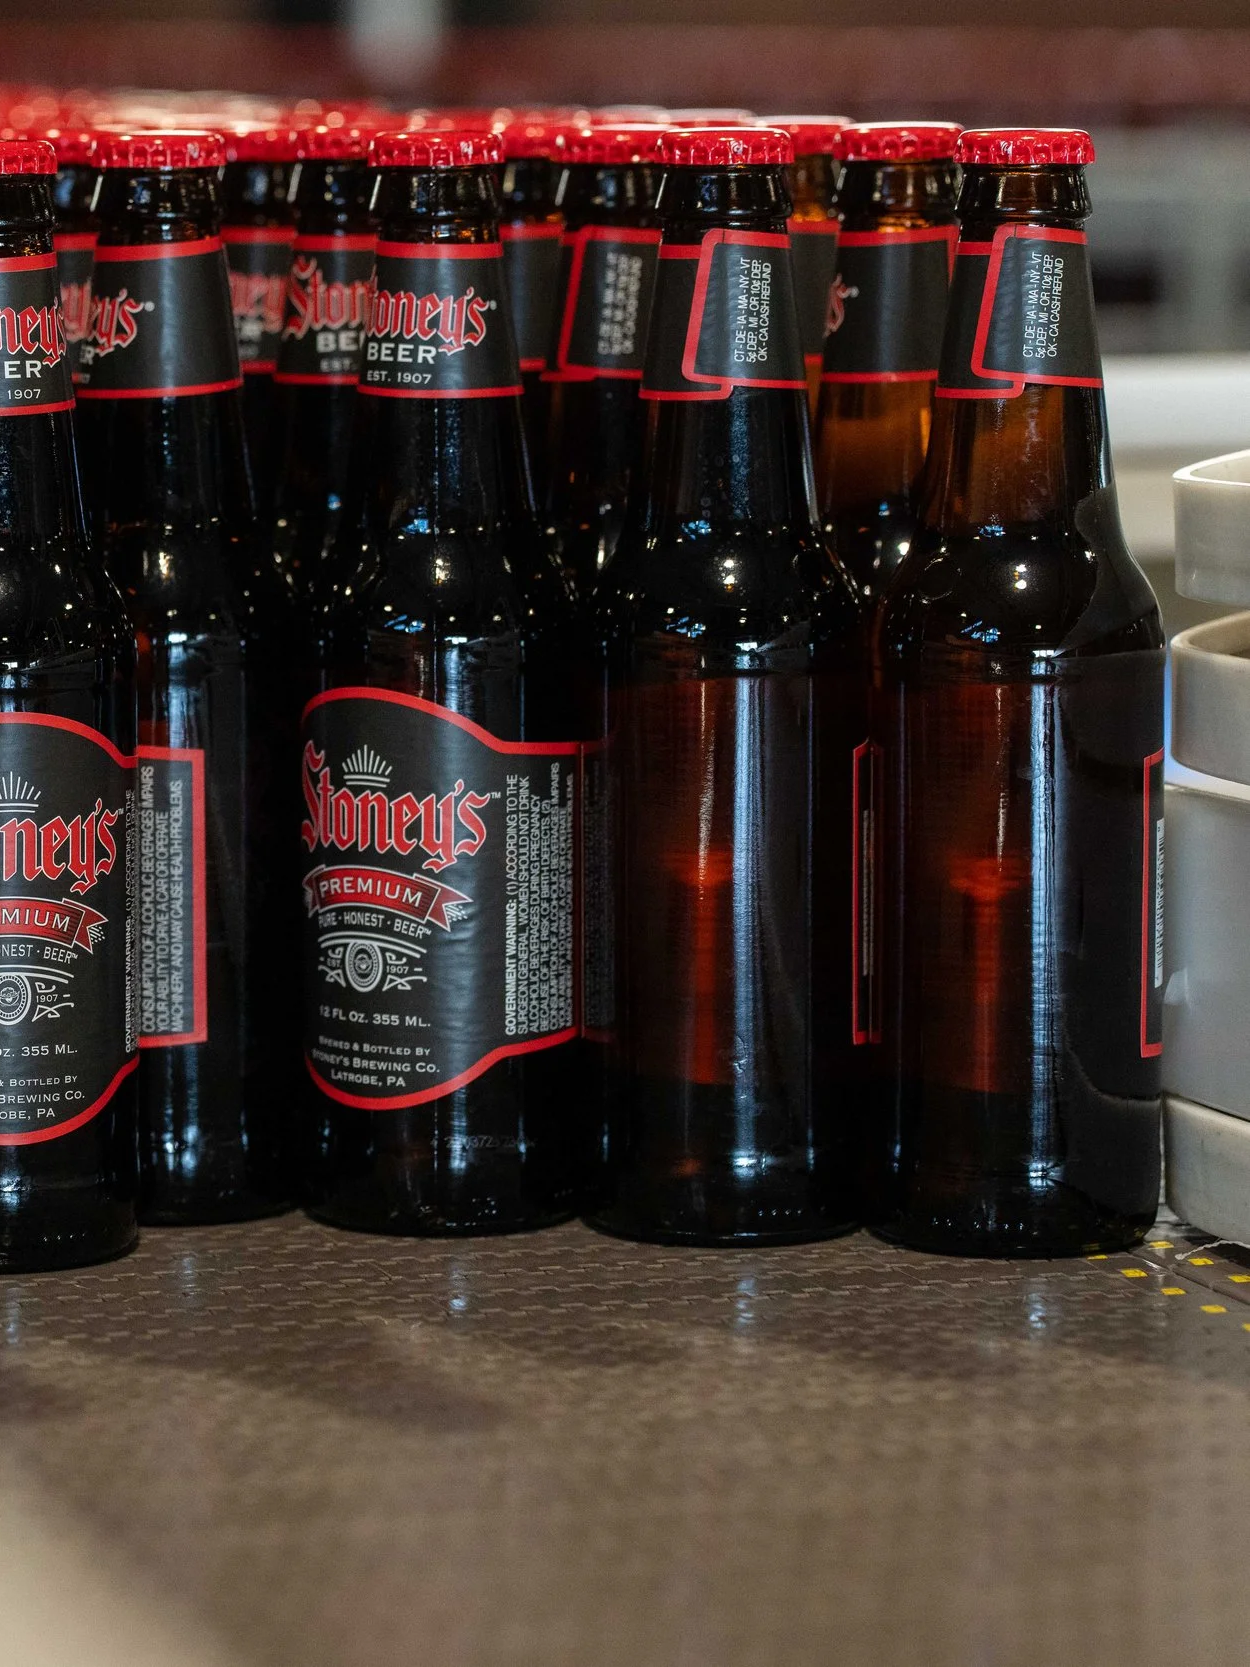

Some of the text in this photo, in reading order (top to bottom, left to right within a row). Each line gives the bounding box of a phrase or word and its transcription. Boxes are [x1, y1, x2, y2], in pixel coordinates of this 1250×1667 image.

[750, 297, 760, 310] OR
[1023, 251, 1042, 357] CT DE IA MA NY VT
[1040, 292, 1050, 306] OR
[1047, 258, 1064, 357] OK CA CASH REFUND
[734, 257, 750, 362] CT DE IA MA NY VT
[758, 263, 771, 361] OK CA CASH REFUND
[1038, 312, 1048, 323] MI
[748, 317, 758, 328] MI
[367, 342, 437, 364] BEER
[397, 372, 432, 384] 1907
[7, 388, 41, 400] 1907
[506, 774, 518, 796] THE
[518, 776, 529, 810] DRINK
[506, 797, 518, 813] TO
[518, 812, 529, 835] NOT
[506, 814, 518, 880] ACCORDING
[518, 837, 529, 881] SHOULD
[319, 877, 422, 907] PREMIUM
[518, 882, 529, 925] WOMEN
[344, 911, 384, 928] HONEST
[386, 966, 409, 974] 1907
[36, 994, 58, 1003] 1907
[505, 957, 517, 1036] GOVERNMENT
[372, 1014, 400, 1026] 355
[21, 1046, 50, 1057] 355
[386, 1076, 406, 1087] PA
[37, 1108, 56, 1118] PA
